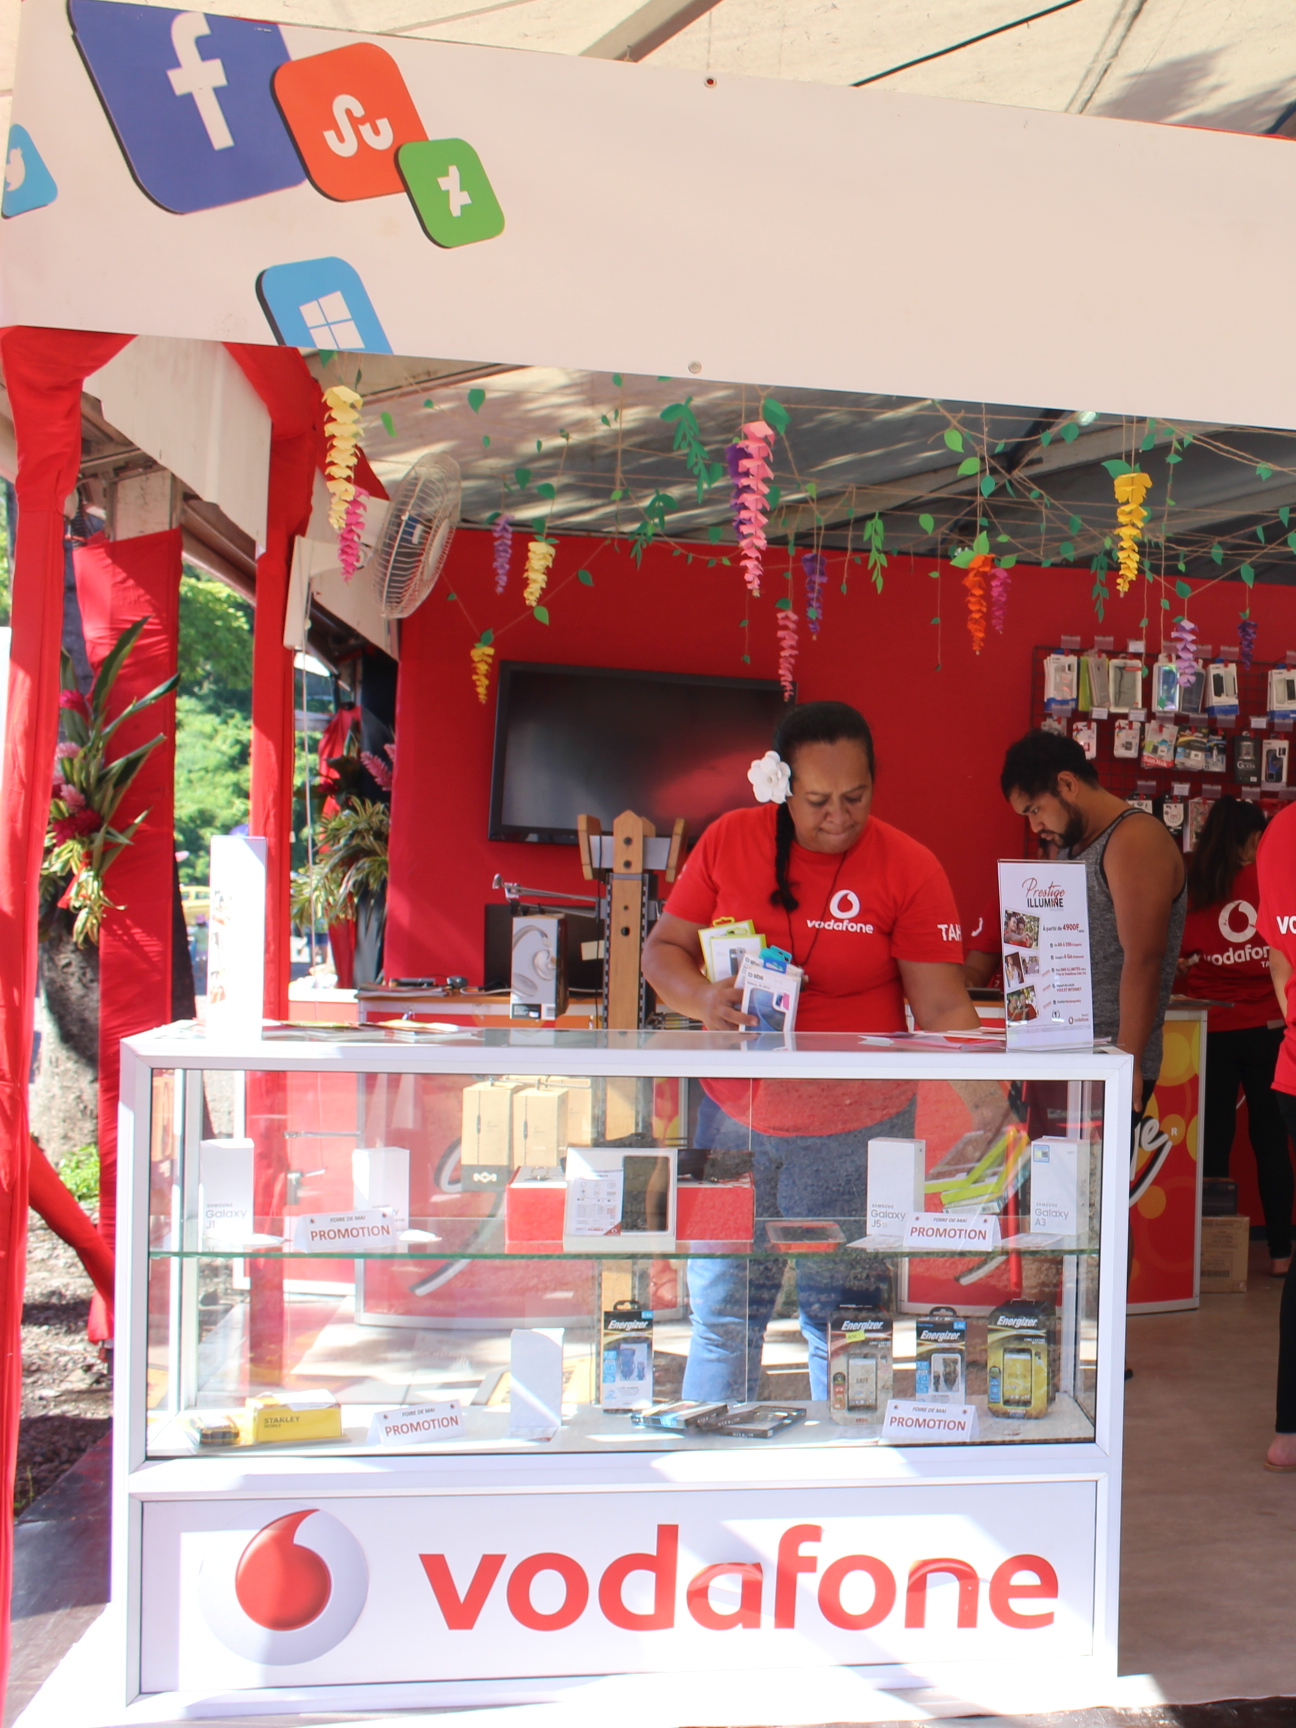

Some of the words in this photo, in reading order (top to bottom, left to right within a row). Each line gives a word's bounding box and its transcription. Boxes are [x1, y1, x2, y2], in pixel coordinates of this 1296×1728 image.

[1142, 755, 1168, 768] SanDisk
[1021, 877, 1066, 906] Prestige
[1027, 897, 1064, 908] ILLUMINE
[806, 919, 874, 934] vodafone
[937, 924, 962, 941] TAH
[1203, 943, 1270, 966] vodafon
[205, 1208, 247, 1220] Galaxy
[870, 1208, 906, 1221] Galaxy
[1034, 1207, 1069, 1220] Galaxy
[205, 1220, 215, 1230] J1
[1034, 1218, 1046, 1227] A3
[310, 1224, 391, 1242] PROMOTION
[909, 1225, 987, 1241] PROMOTION
[608, 1319, 649, 1331] Energizer
[841, 1319, 884, 1331] Energizer
[996, 1315, 1039, 1328] Energizer
[920, 1330, 961, 1341] Energizer
[264, 1415, 300, 1424] STANLEY
[385, 1415, 459, 1437] PROMOTION
[889, 1416, 967, 1431] PROMOTION
[419, 1522, 1059, 1632] vodafone
